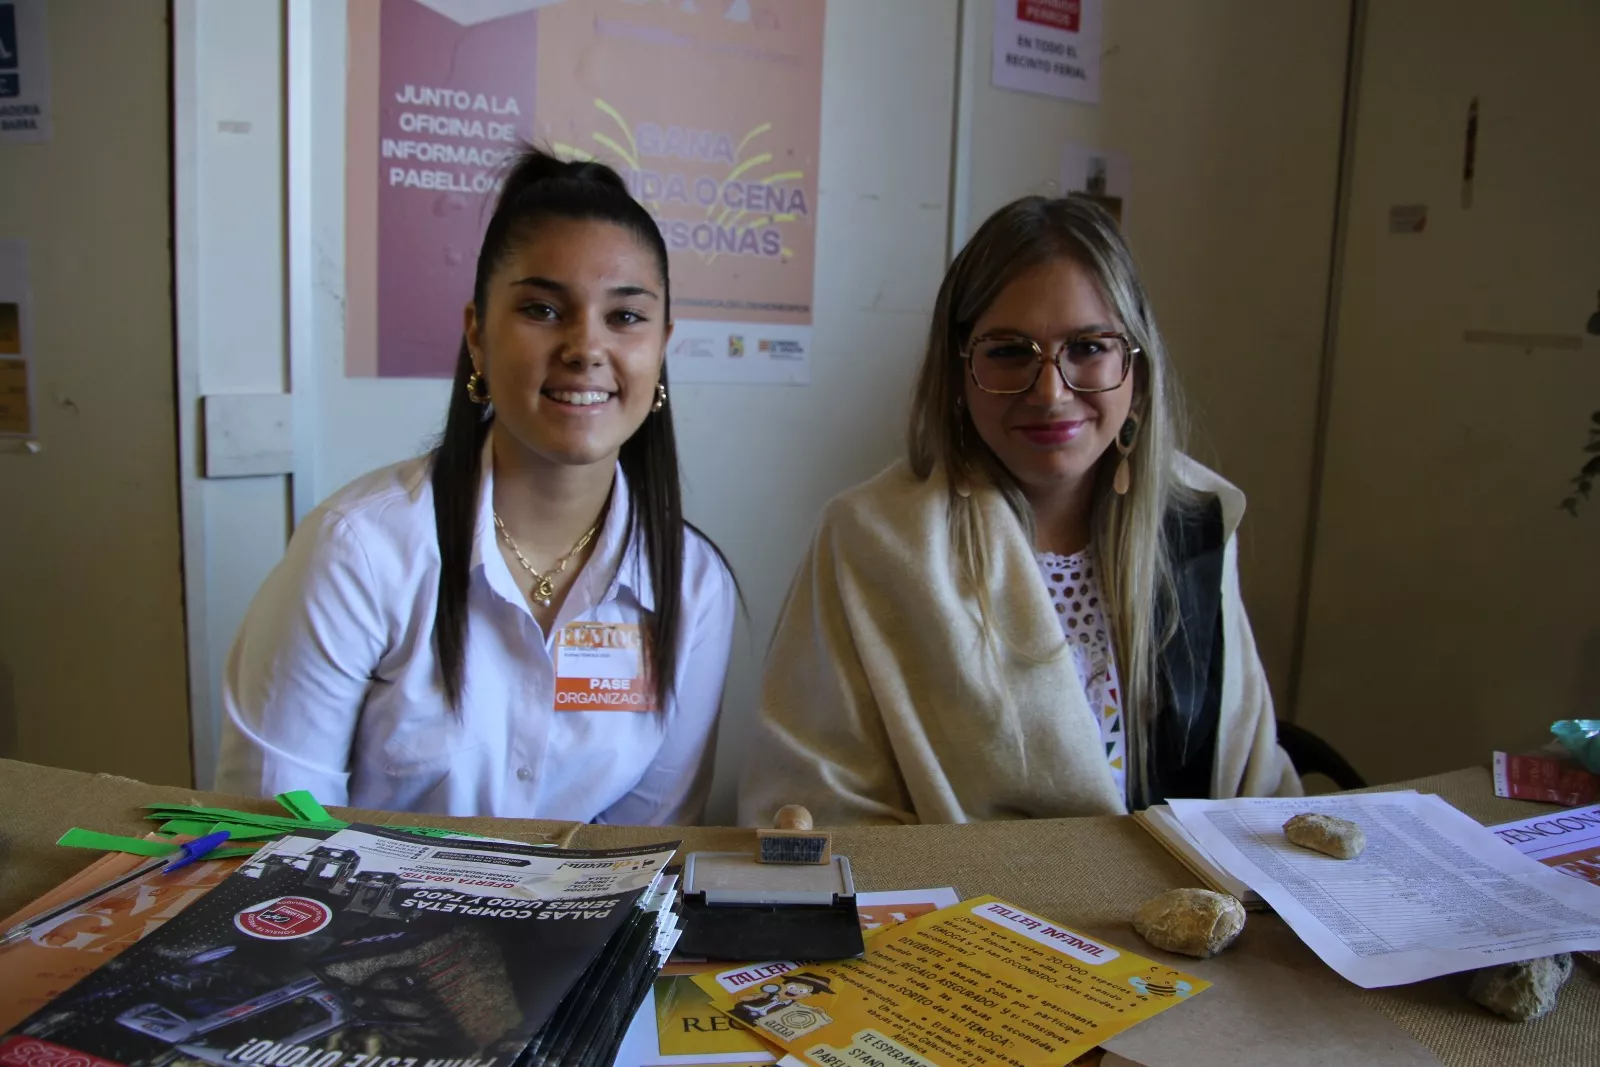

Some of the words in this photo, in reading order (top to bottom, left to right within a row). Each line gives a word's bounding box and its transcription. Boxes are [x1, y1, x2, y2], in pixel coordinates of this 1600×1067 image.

[1017, 34, 1032, 48] EN
[1034, 38, 1064, 55] TODO
[1066, 46, 1077, 59] EL
[1006, 52, 1051, 73] RECINTO
[1052, 62, 1087, 81] FERIAL
[396, 84, 470, 110] JUNTO
[472, 94, 490, 112] A
[492, 95, 520, 116] LA
[398, 112, 485, 139] OFICINA
[488, 122, 516, 142] DE
[636, 122, 735, 164] GANA
[695, 178, 718, 205] O
[722, 182, 808, 215] CENA
[590, 678, 630, 690] PASE
[402, 872, 456, 883] GRATIS!
[458, 878, 515, 890] OFERTA
[400, 898, 532, 920] COMPLETAS
[413, 890, 466, 903] T400
[468, 894, 480, 904] Y
[488, 898, 544, 910] U400
[546, 898, 620, 910] SERIES
[536, 908, 612, 920] PALAS
[988, 904, 1042, 930] TALLER
[1040, 926, 1104, 958] INFANTIL
[722, 963, 792, 986] TALLER
[929, 924, 967, 943] FEMOGA
[985, 949, 1001, 958] han
[1083, 993, 1116, 1009] ayudas
[944, 920, 978, 935] abejas?
[980, 937, 1014, 954] Algunas
[1039, 964, 1059, 974] ellas
[1066, 975, 1082, 984] han
[1090, 986, 1122, 1001] venido
[1010, 940, 1044, 956] existen
[1046, 956, 1088, 976] 20.000
[1090, 976, 1132, 995] especies
[871, 950, 897, 963] tienes
[936, 978, 999, 1009] ASEGURADO!
[1021, 1019, 1071, 1045] consigues
[885, 944, 912, 956] mundo
[932, 962, 945, 970] las
[985, 987, 1008, 1000] Solo
[1010, 1000, 1031, 1010] por
[1034, 1011, 1084, 1036] participar
[896, 986, 934, 1006] SORTEO
[932, 1005, 950, 1014] del
[957, 962, 992, 979] aprende
[996, 980, 1022, 994] sobre
[1041, 1000, 1098, 1028] apasionante
[856, 957, 898, 976] encontrar
[906, 977, 931, 991] todas
[939, 992, 953, 1001] las
[960, 1004, 992, 1021] abejas
[1001, 1024, 1056, 1053] escondidas
[860, 1033, 876, 1044] TE
[867, 1009, 892, 1024] abejas
[919, 1037, 955, 1059] Galachos
[878, 1004, 890, 1012] Un
[891, 1011, 910, 1023] viaje
[909, 1021, 926, 1031] por
[935, 1034, 962, 1051] mundo
[974, 1056, 988, 1064] las
[891, 1033, 928, 1054] Alfranca
[942, 1024, 961, 1038] libro
[977, 1044, 996, 1055] vida
[848, 1048, 884, 1067] STAND
